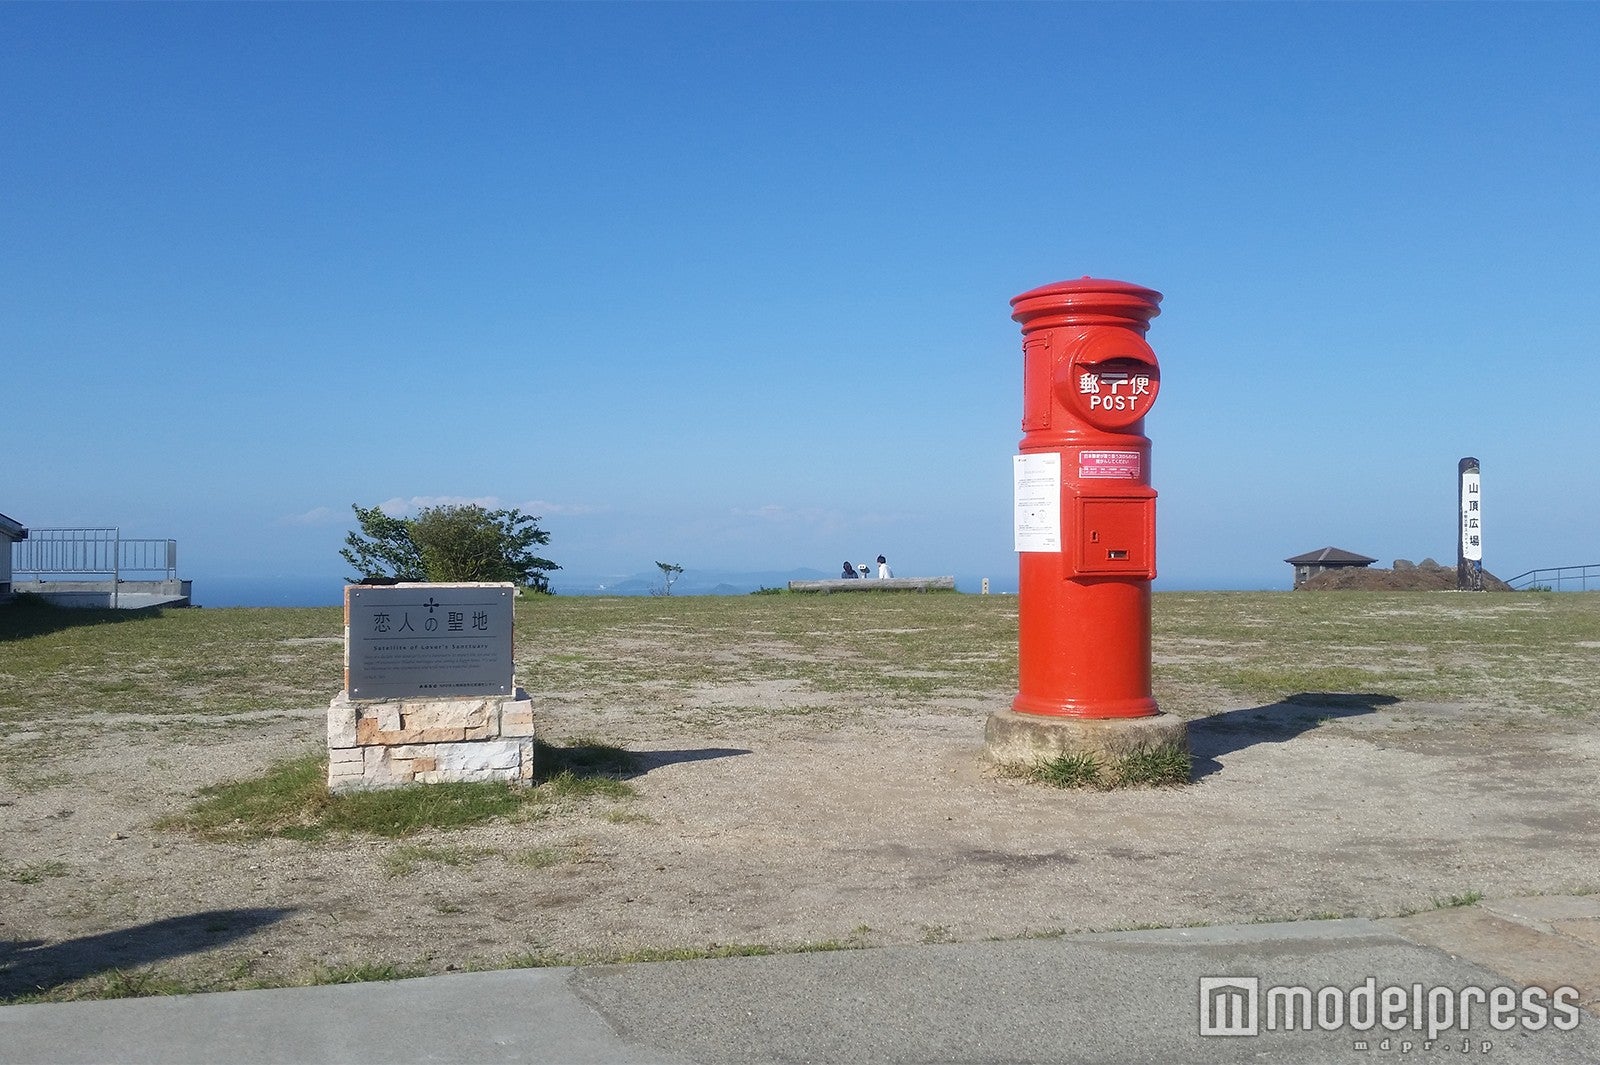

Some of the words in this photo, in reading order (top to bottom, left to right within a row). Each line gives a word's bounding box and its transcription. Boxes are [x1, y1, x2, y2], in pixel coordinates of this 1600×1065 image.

[1090, 395, 1138, 411] POST
[1468, 482, 1480, 547] 山頂広場
[374, 611, 489, 633] 恋人の聖地
